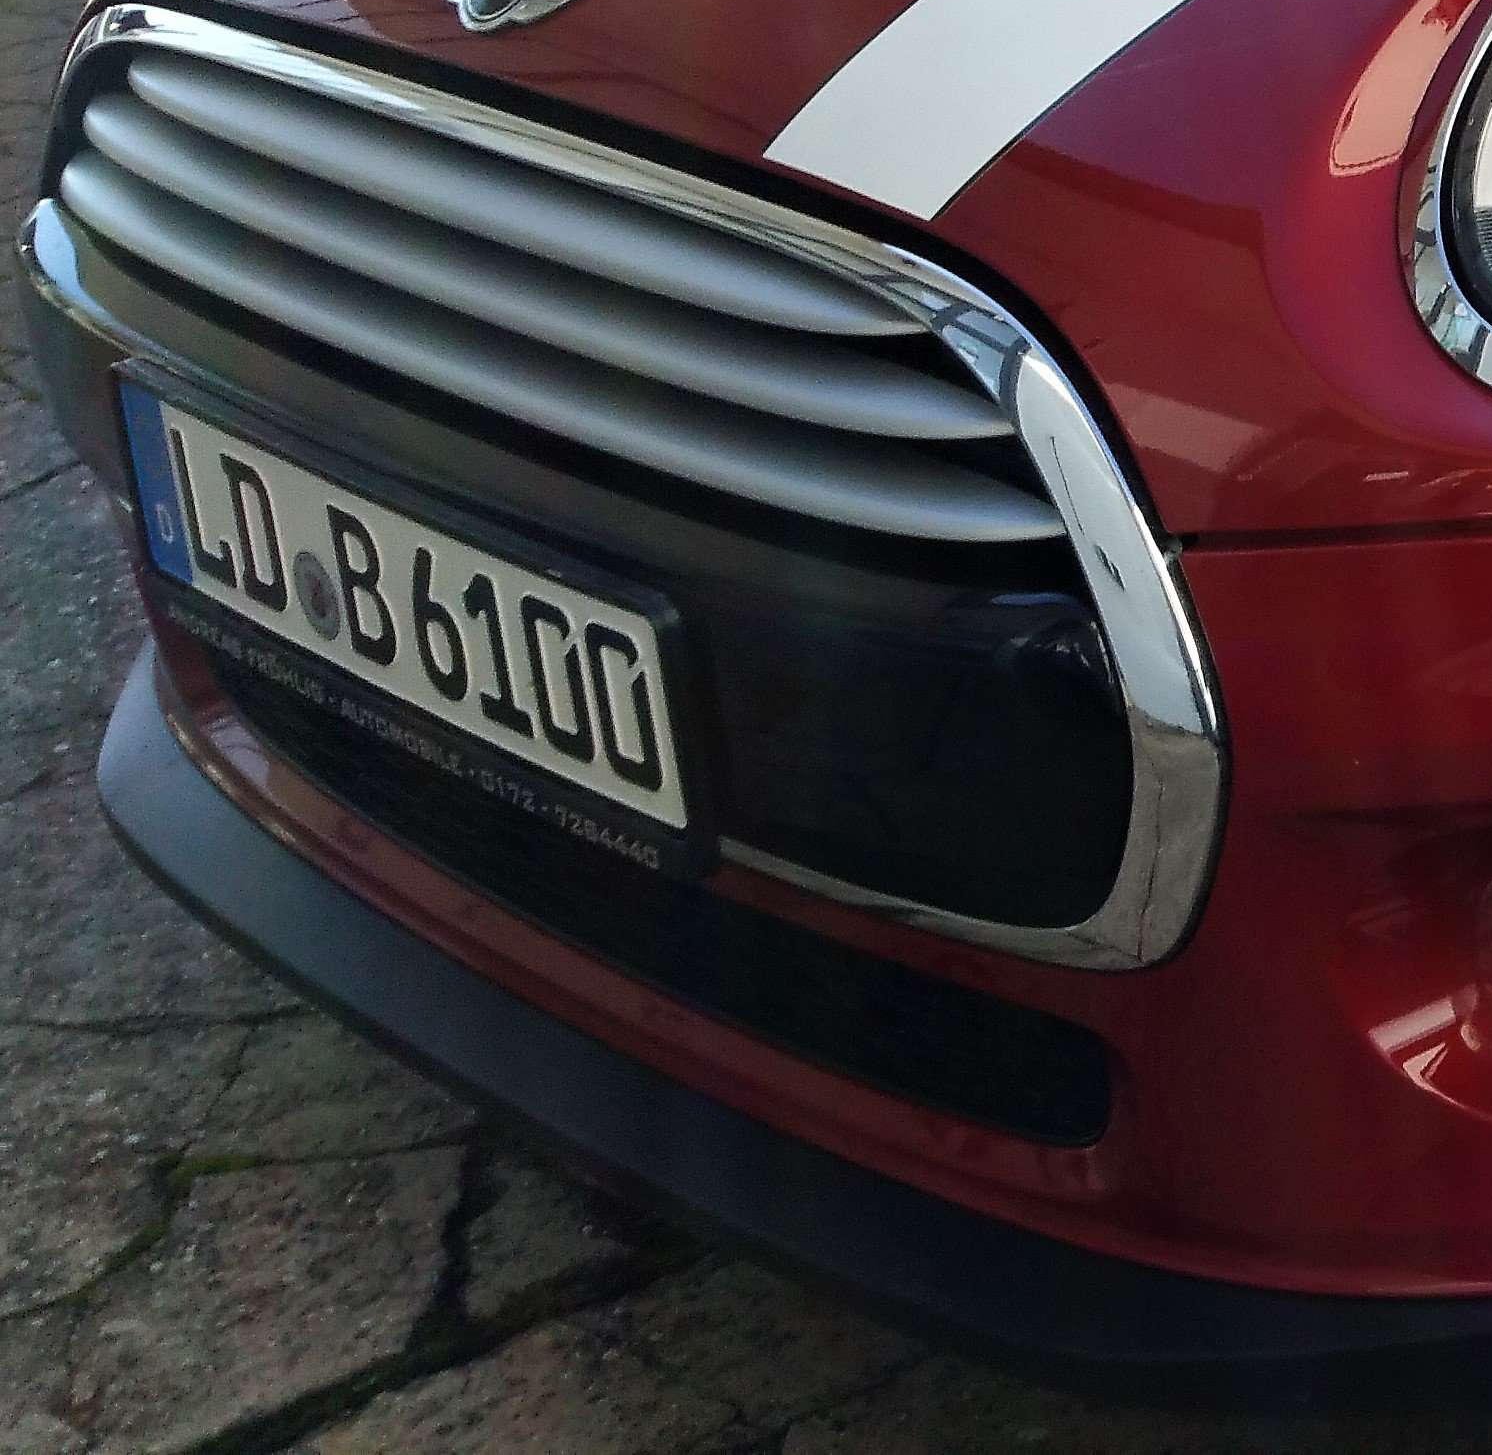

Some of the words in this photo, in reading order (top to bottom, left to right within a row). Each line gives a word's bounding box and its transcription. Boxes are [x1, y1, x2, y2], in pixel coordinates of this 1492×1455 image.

[169, 427, 288, 613] LD
[326, 502, 397, 667] B
[411, 546, 663, 793] 6100
